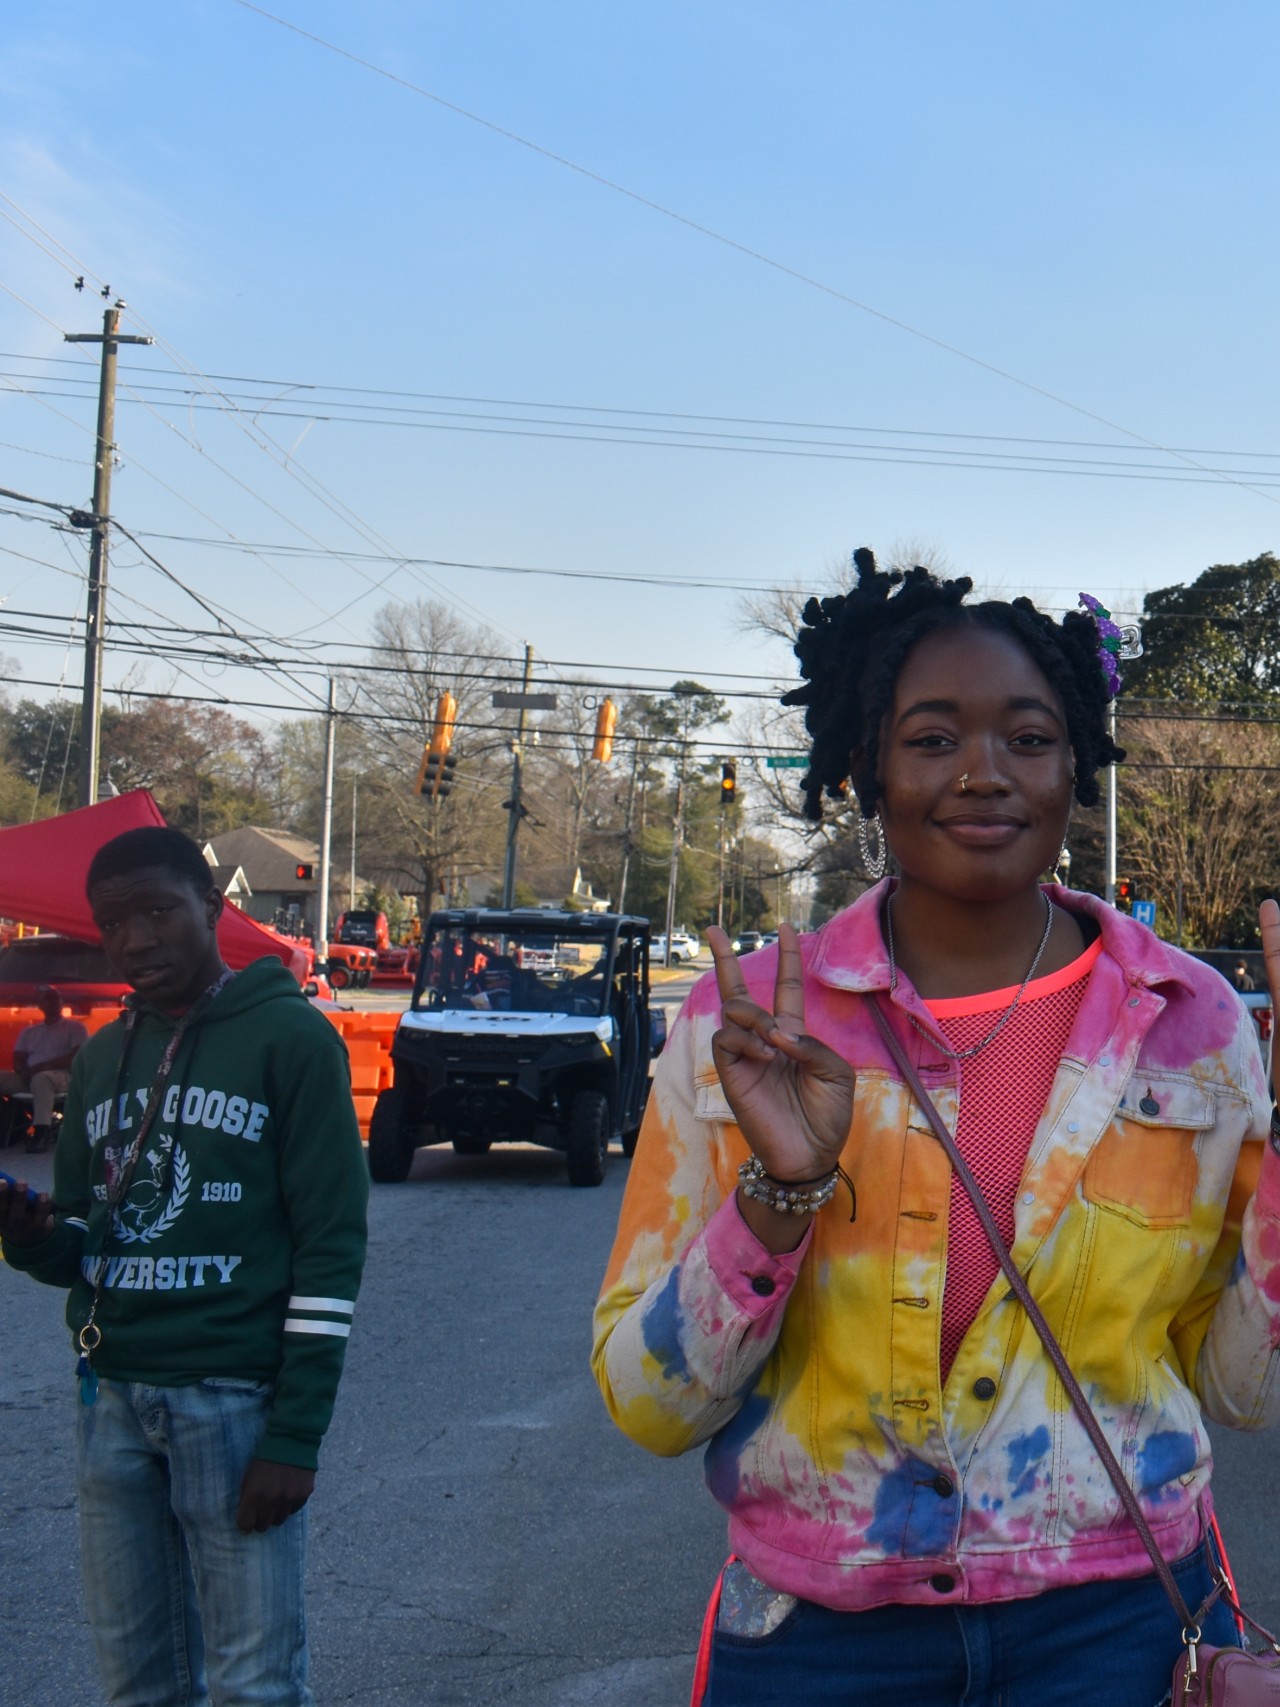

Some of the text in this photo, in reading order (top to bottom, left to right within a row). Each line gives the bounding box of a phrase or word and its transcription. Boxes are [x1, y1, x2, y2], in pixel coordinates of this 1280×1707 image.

[1136, 904, 1151, 923] H
[162, 1085, 270, 1143] GOOSE
[93, 1181, 242, 1202] ES 1910
[81, 1255, 242, 1291] UNVERSITY
